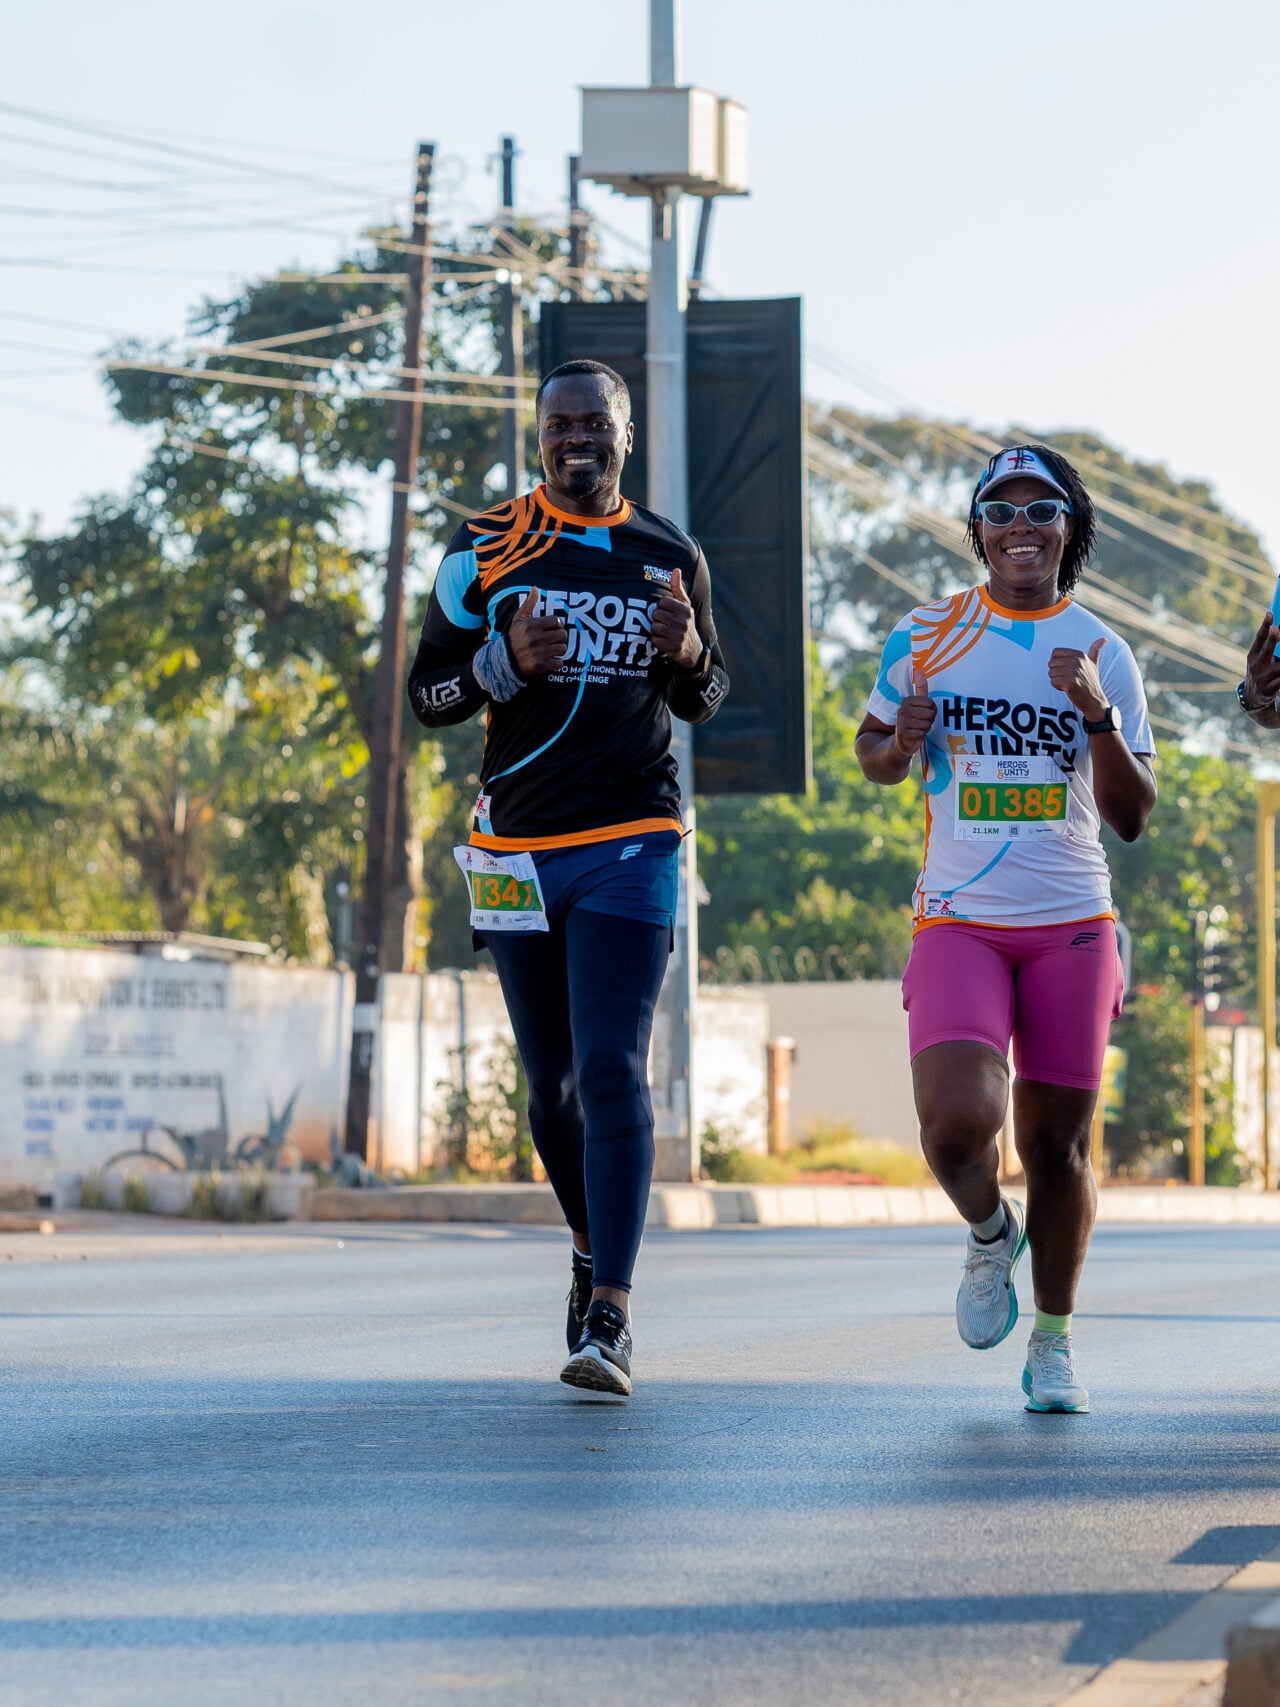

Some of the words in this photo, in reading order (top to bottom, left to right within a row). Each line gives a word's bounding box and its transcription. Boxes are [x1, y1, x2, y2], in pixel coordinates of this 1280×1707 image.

[547, 674, 565, 684] ONE
[942, 695, 1078, 743] HEROES
[996, 760, 1028, 769] HEROES
[1004, 769, 1030, 777] UNITY
[962, 786, 1063, 818] 01385
